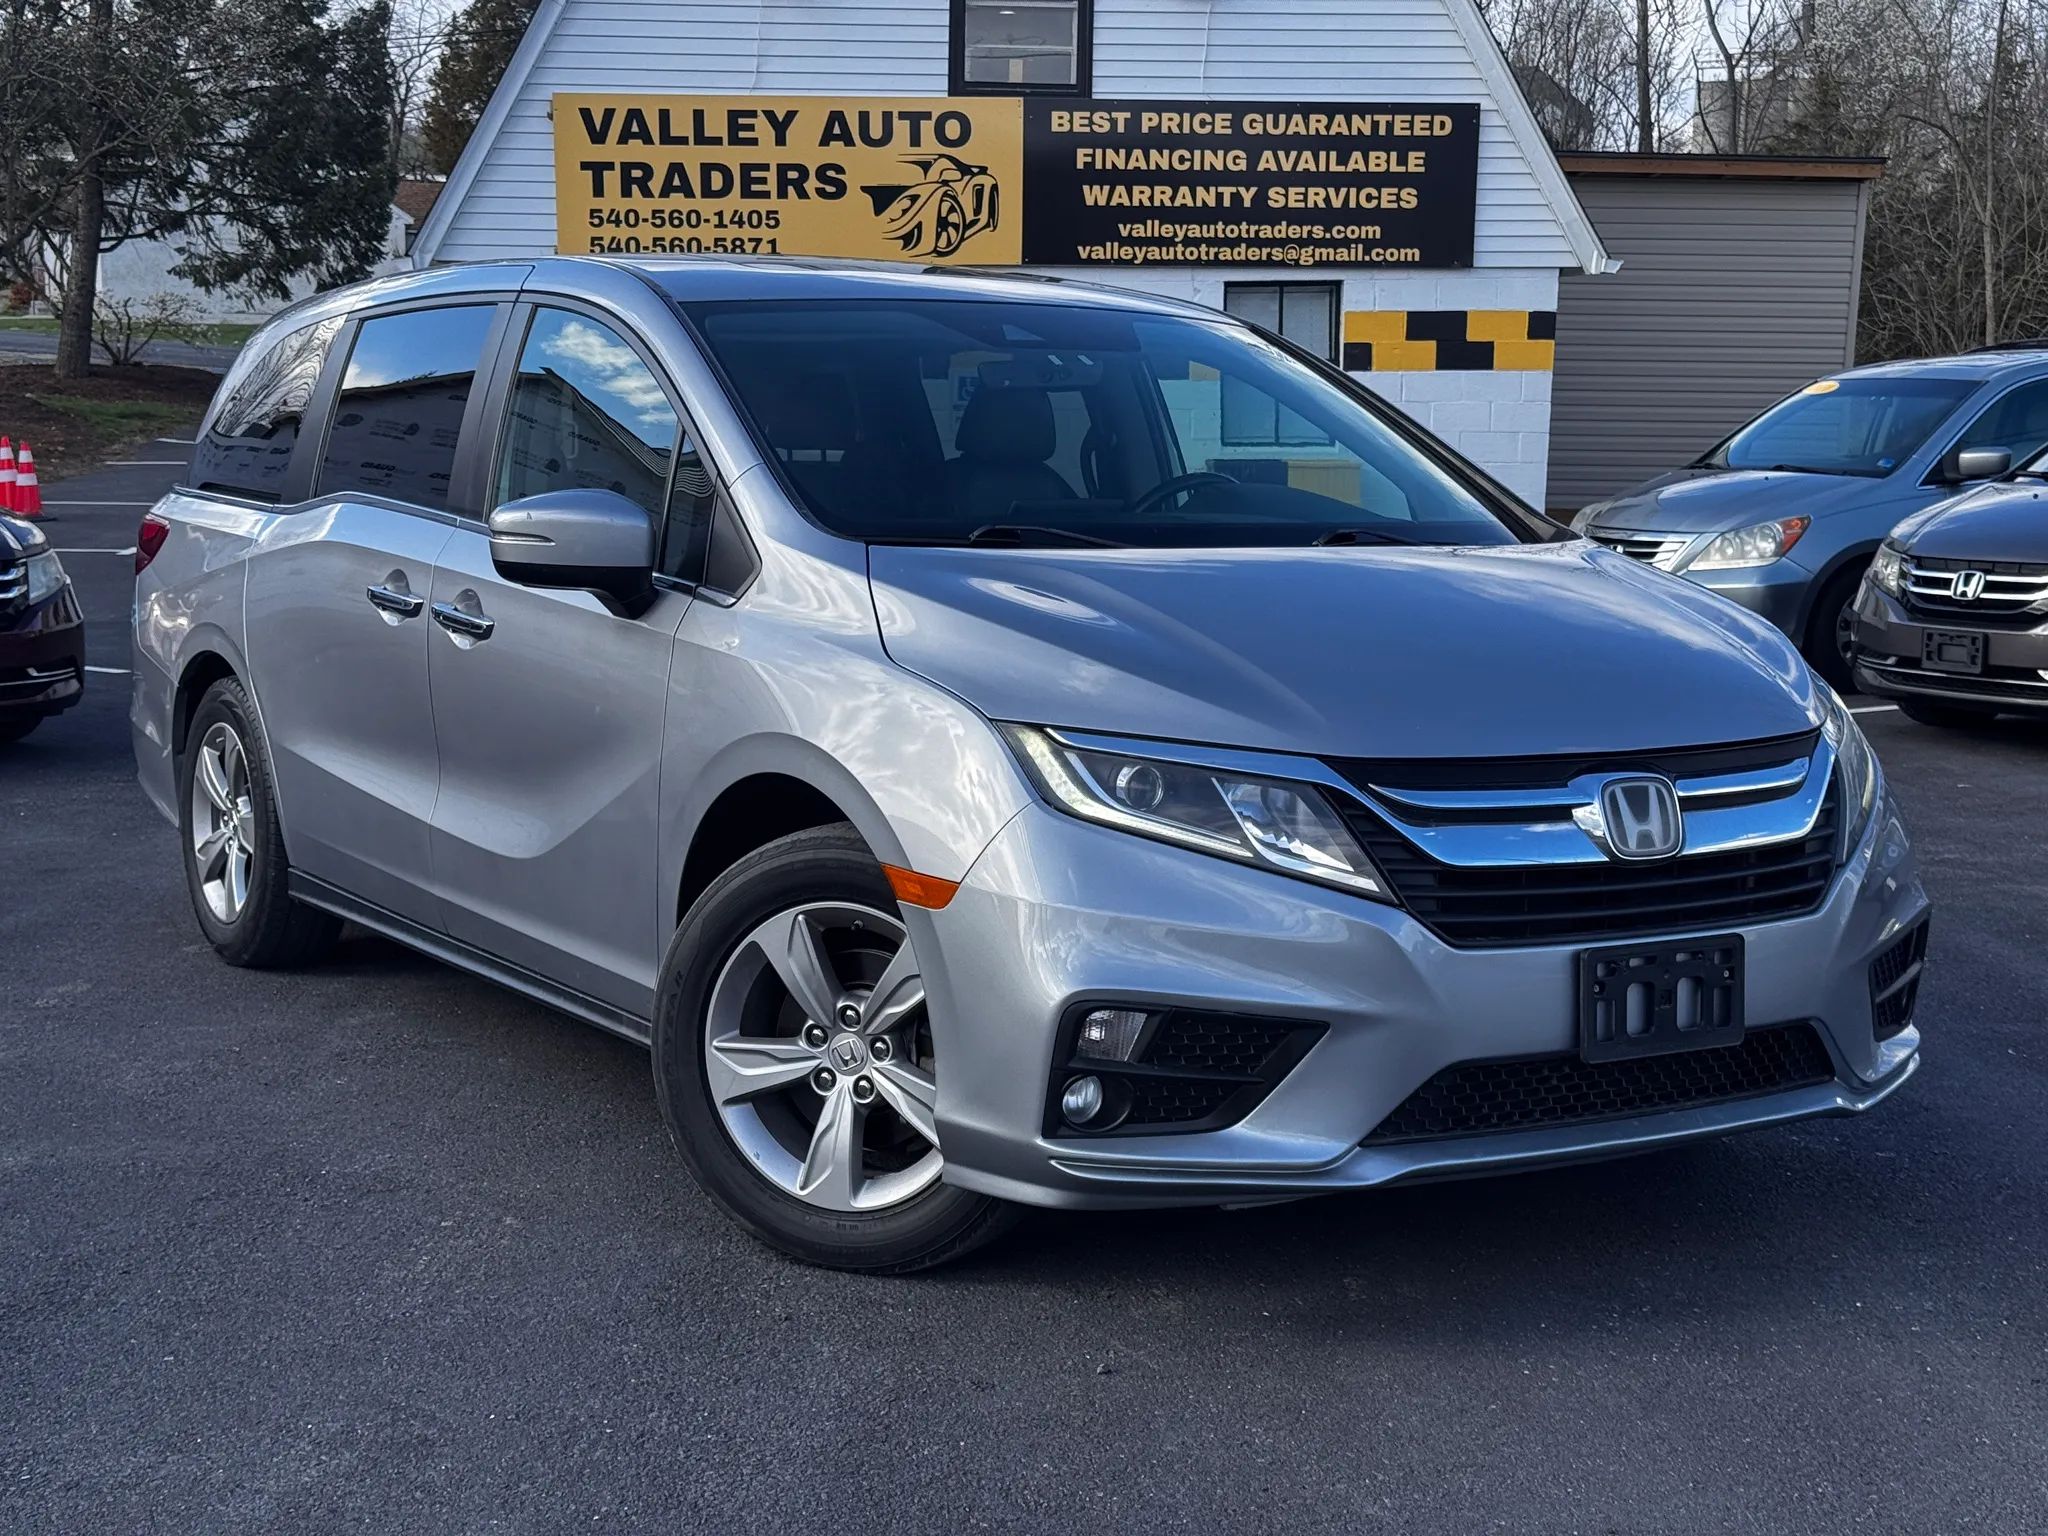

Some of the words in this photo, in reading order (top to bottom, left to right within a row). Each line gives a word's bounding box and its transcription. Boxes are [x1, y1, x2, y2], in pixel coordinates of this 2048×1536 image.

[578, 107, 800, 148] VALLEY
[817, 110, 973, 149] AUTO
[1050, 110, 1132, 135] BEST
[1140, 111, 1233, 136] PRICE
[1241, 113, 1454, 138] GUARANTEED
[1075, 148, 1248, 172] FINANCING
[1256, 150, 1427, 174] AVAILABLE
[579, 160, 849, 201] TRADERS
[1081, 184, 1259, 208] WARRANTY
[1266, 186, 1419, 210] SERVICES
[588, 208, 781, 231] 540-560-1405
[1117, 219, 1381, 243] valleyautotraders.com
[588, 236, 781, 255] 540-560-5871
[1077, 243, 1421, 266] valleyautotraders@gmail.com
